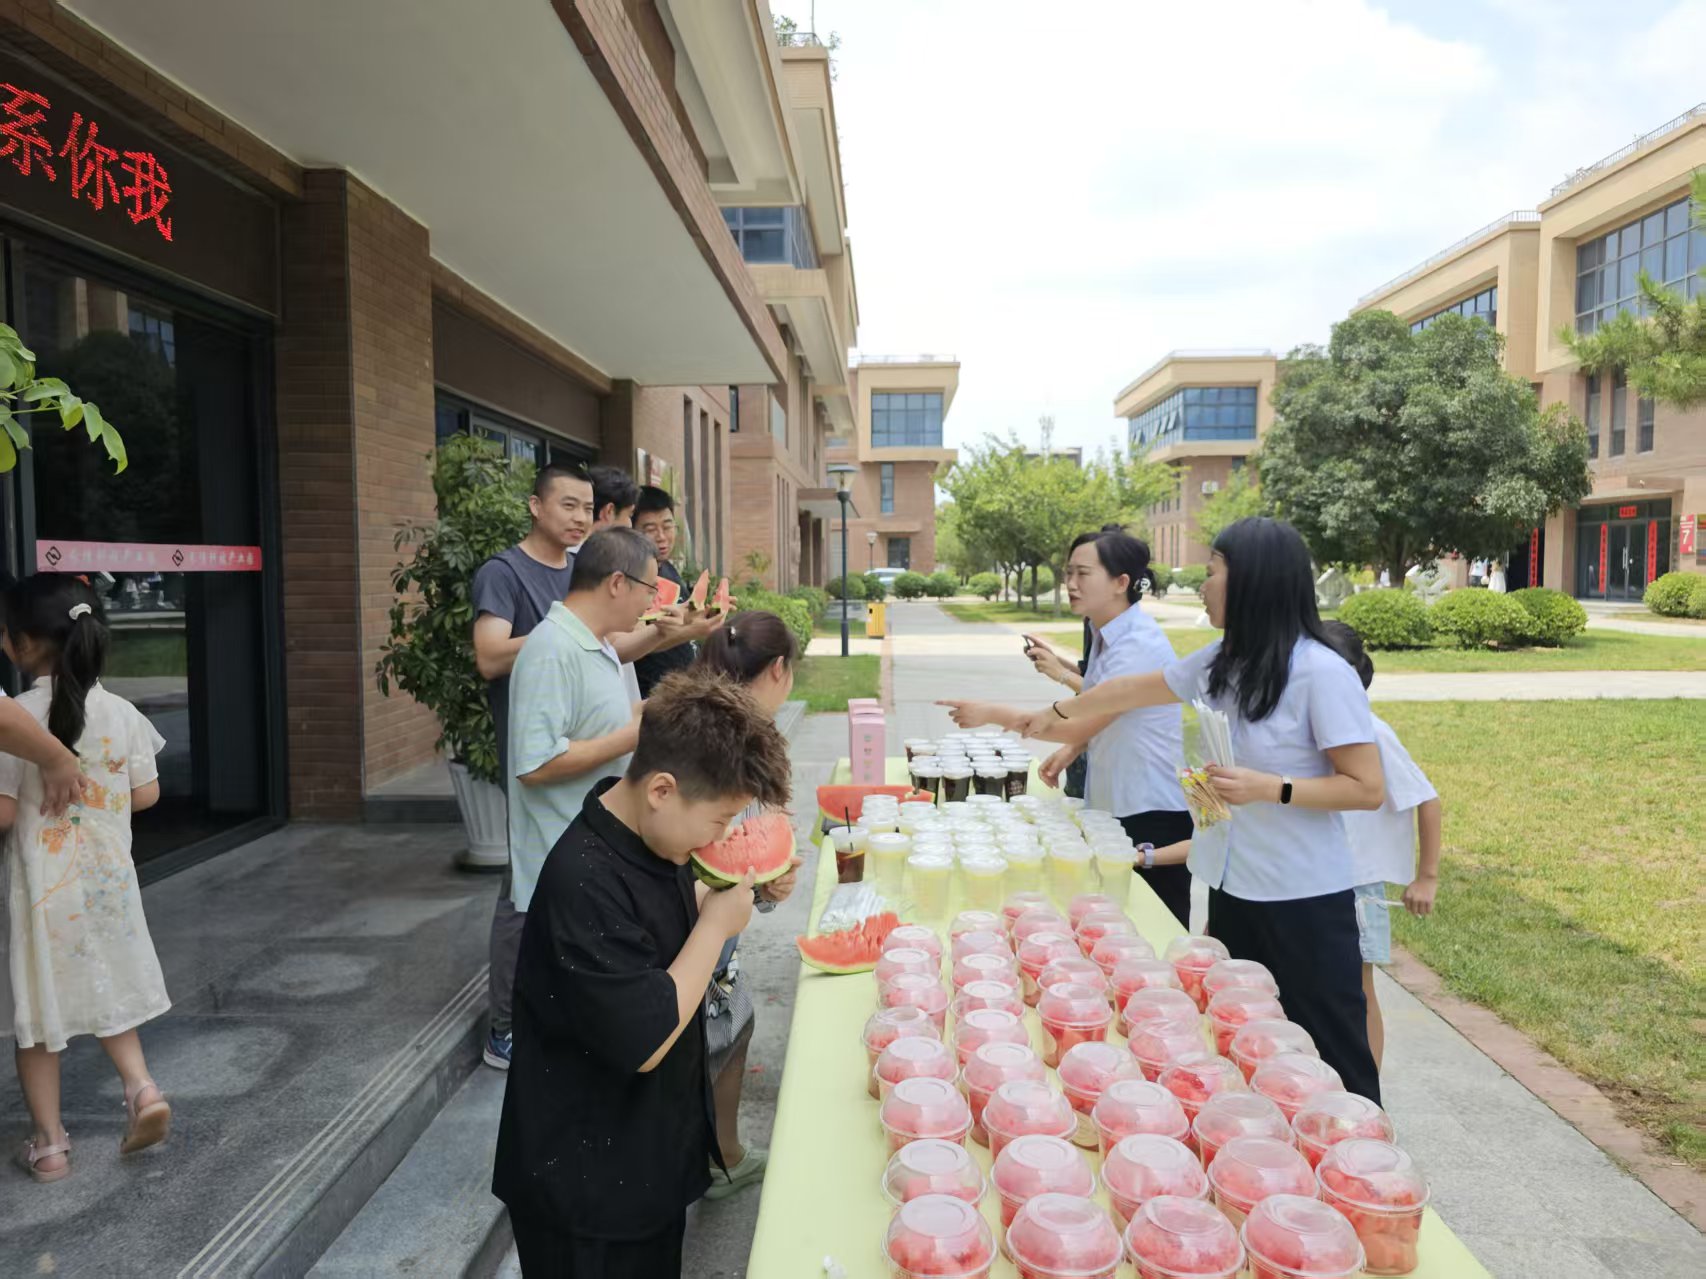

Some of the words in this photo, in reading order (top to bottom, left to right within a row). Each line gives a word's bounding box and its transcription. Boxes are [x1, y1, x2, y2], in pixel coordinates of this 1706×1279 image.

[0, 83, 173, 242] 系你我
[1682, 529, 1690, 544] 7
